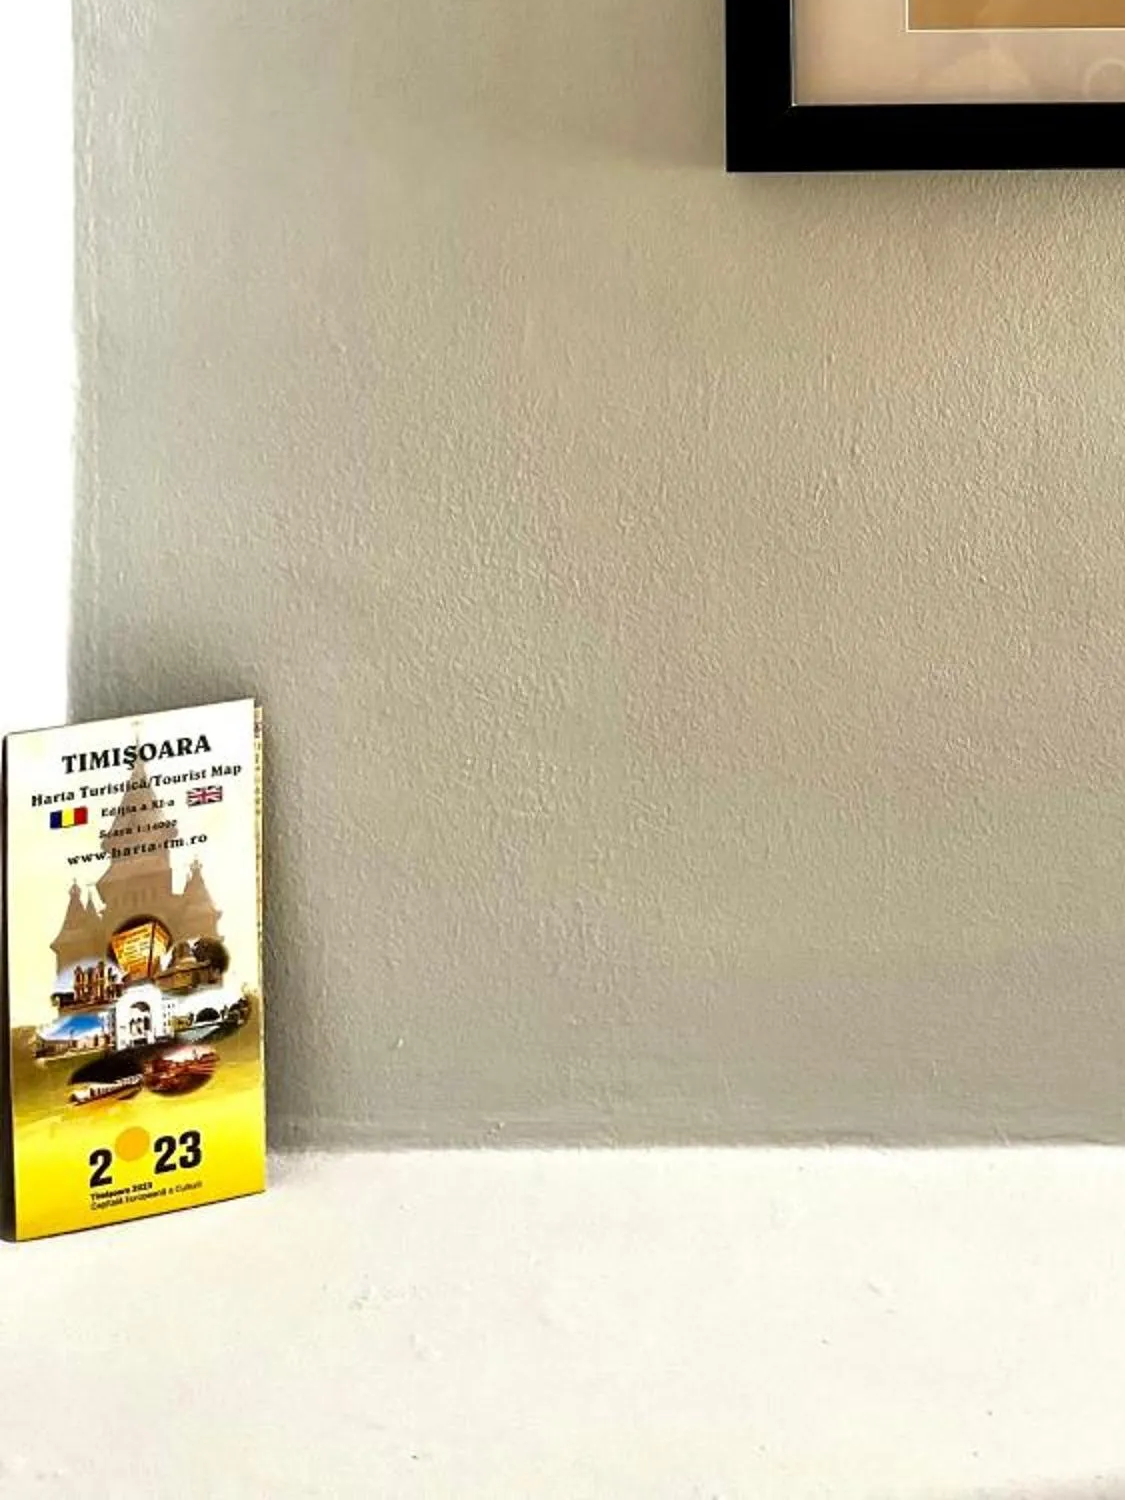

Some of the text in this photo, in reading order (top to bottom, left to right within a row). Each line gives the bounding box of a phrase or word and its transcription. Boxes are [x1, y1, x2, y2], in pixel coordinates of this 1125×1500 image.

[31, 791, 75, 807] Harta
[211, 763, 242, 777] Map
[67, 833, 208, 865] www.harta-tm.ro
